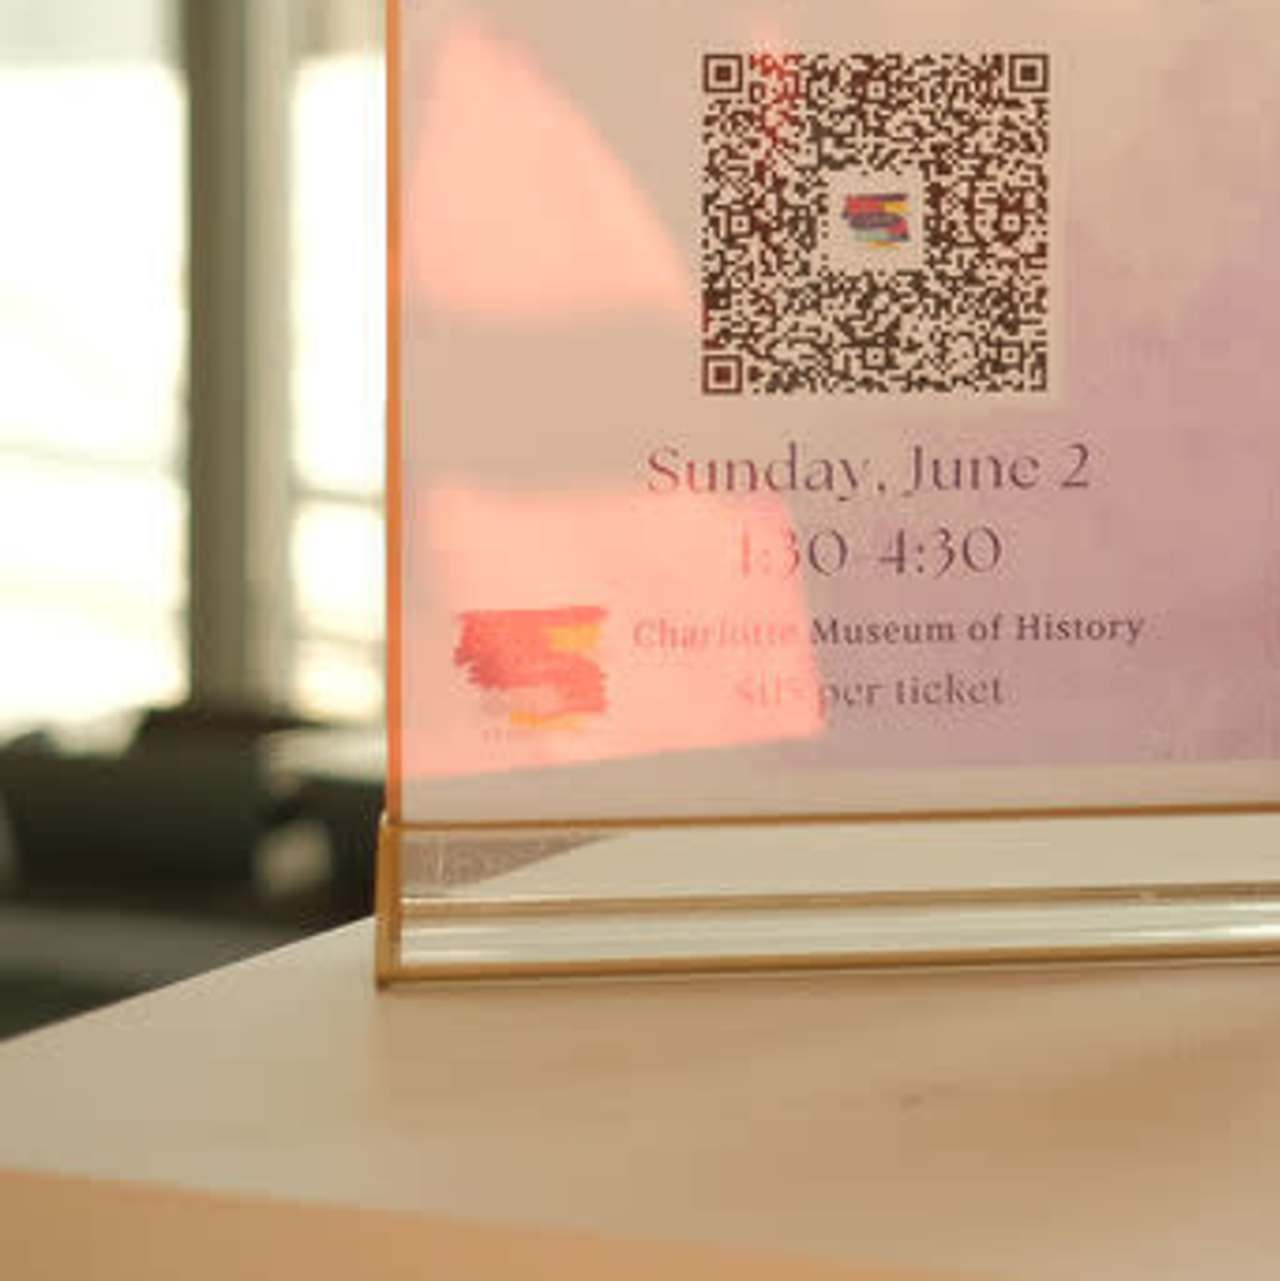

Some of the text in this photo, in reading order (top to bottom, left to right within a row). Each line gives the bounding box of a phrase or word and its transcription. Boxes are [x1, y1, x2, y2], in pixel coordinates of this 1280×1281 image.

[647, 440, 1093, 501] Sunday, June 2
[632, 614, 1147, 650] Charlotte Museum of History
[816, 681, 883, 719] per
[895, 673, 1004, 706] ticket
